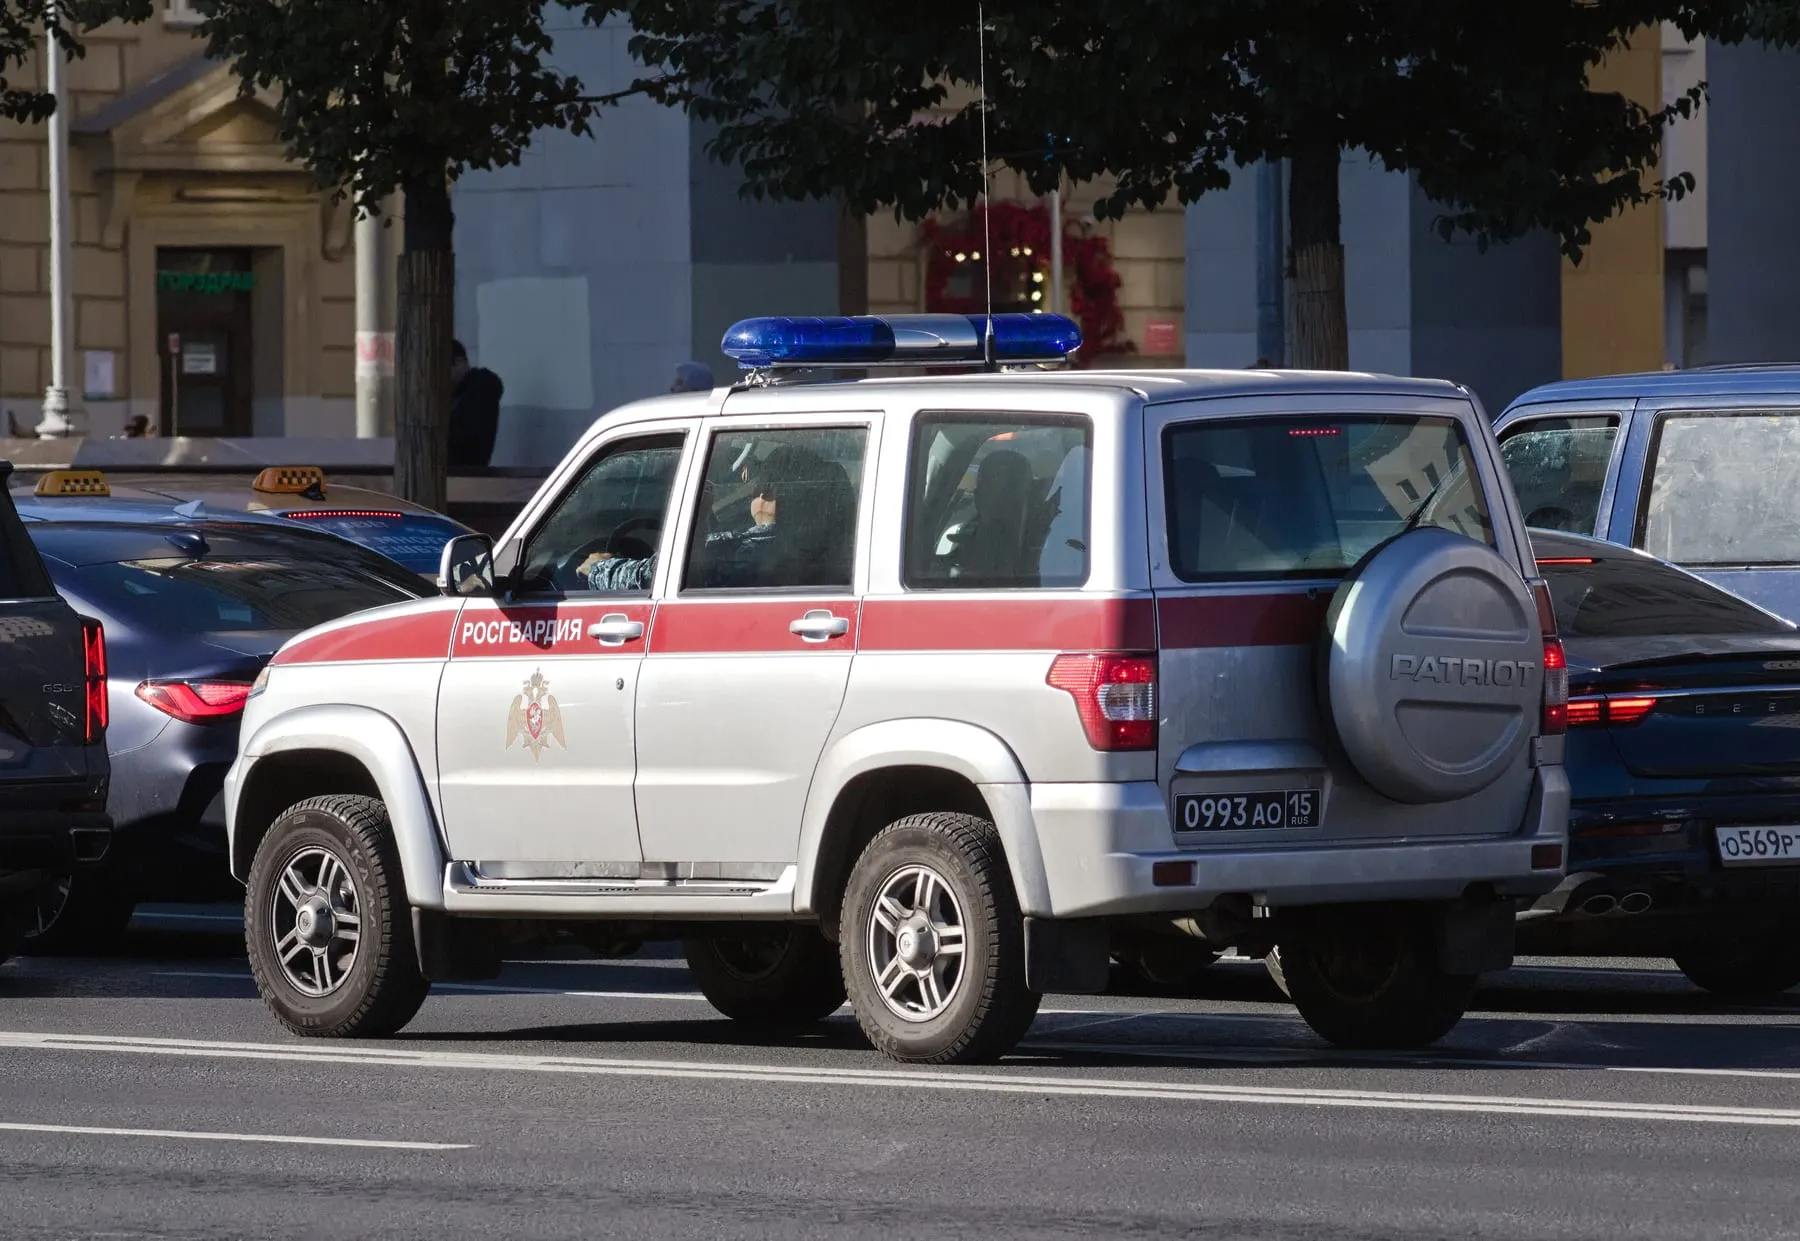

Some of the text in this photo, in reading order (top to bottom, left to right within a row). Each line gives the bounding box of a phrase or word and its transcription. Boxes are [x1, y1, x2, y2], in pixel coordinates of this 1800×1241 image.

[461, 618, 583, 645] РОСГВАРДИЯ
[1390, 653, 1535, 687] PATRIOT
[1184, 797, 1247, 828] 0993
[1289, 793, 1312, 816] 15
[1291, 816, 1309, 825] RUS
